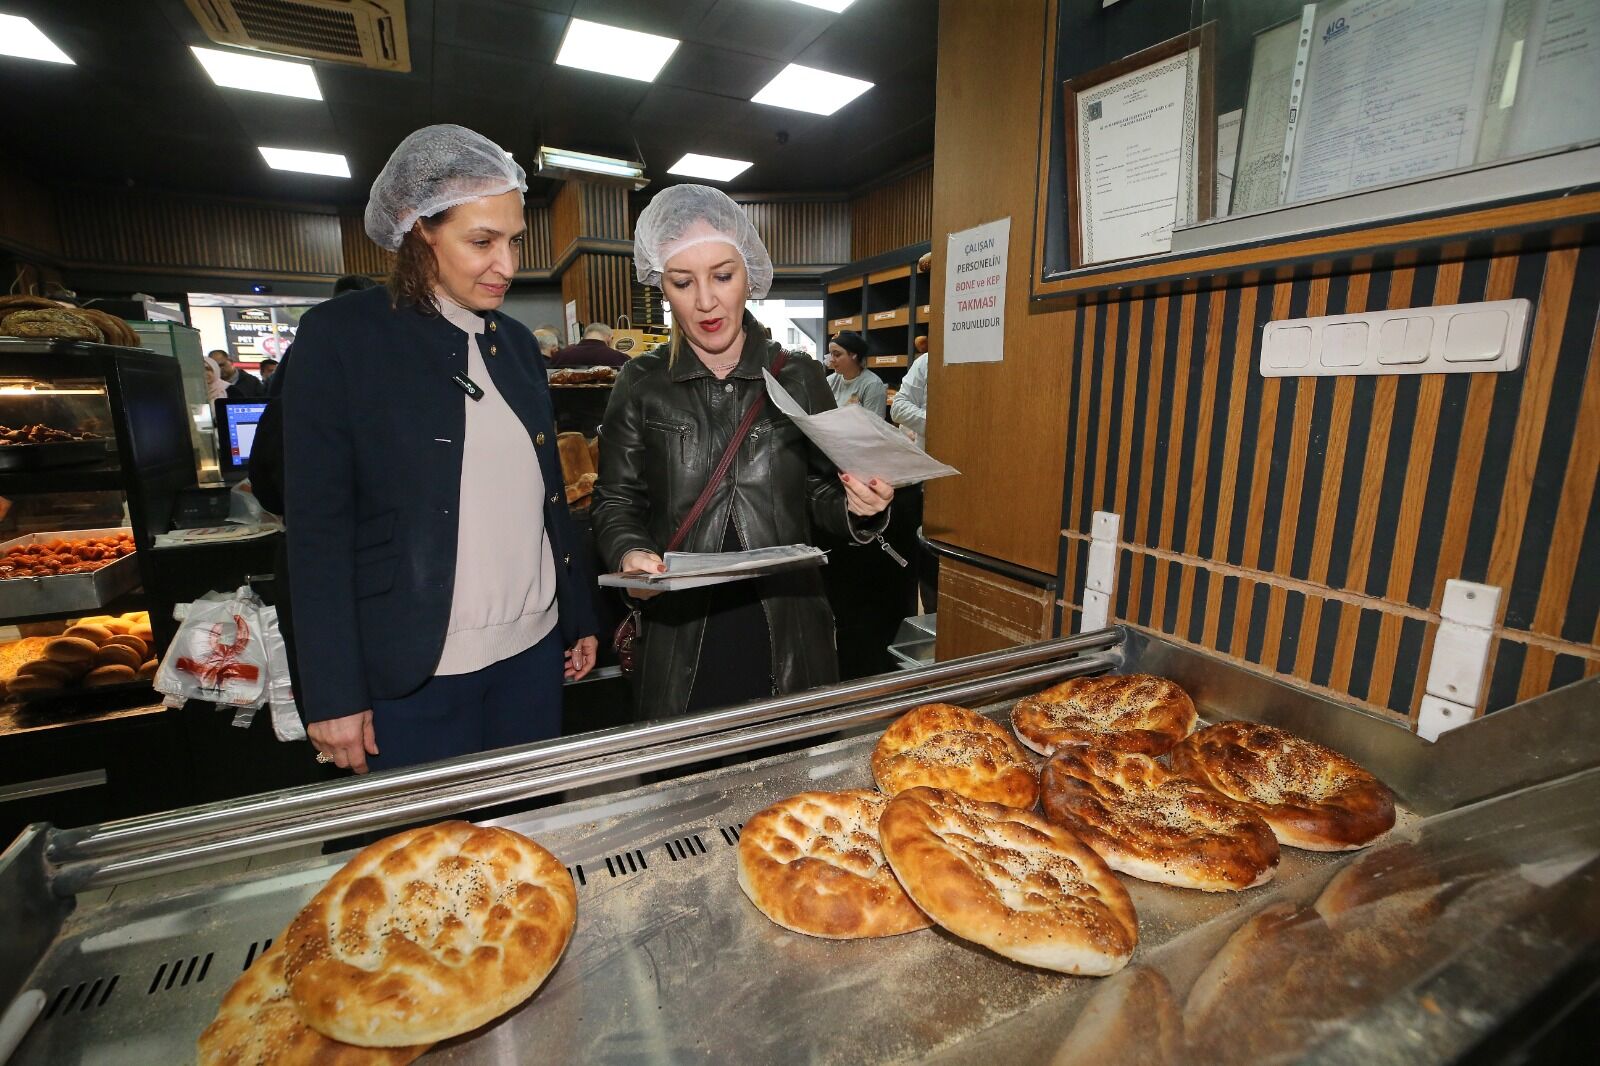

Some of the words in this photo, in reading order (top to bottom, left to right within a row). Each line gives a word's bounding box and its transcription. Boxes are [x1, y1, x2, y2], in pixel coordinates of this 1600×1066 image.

[964, 238, 995, 256] ÇALIŞAN
[957, 255, 1001, 273] PERSONELİN
[955, 279, 975, 292] BONE
[976, 280, 985, 288] ve
[986, 275, 1000, 286] KEP
[957, 295, 996, 312] TAKMASI
[952, 317, 1000, 332] ZORUNLUDUR
